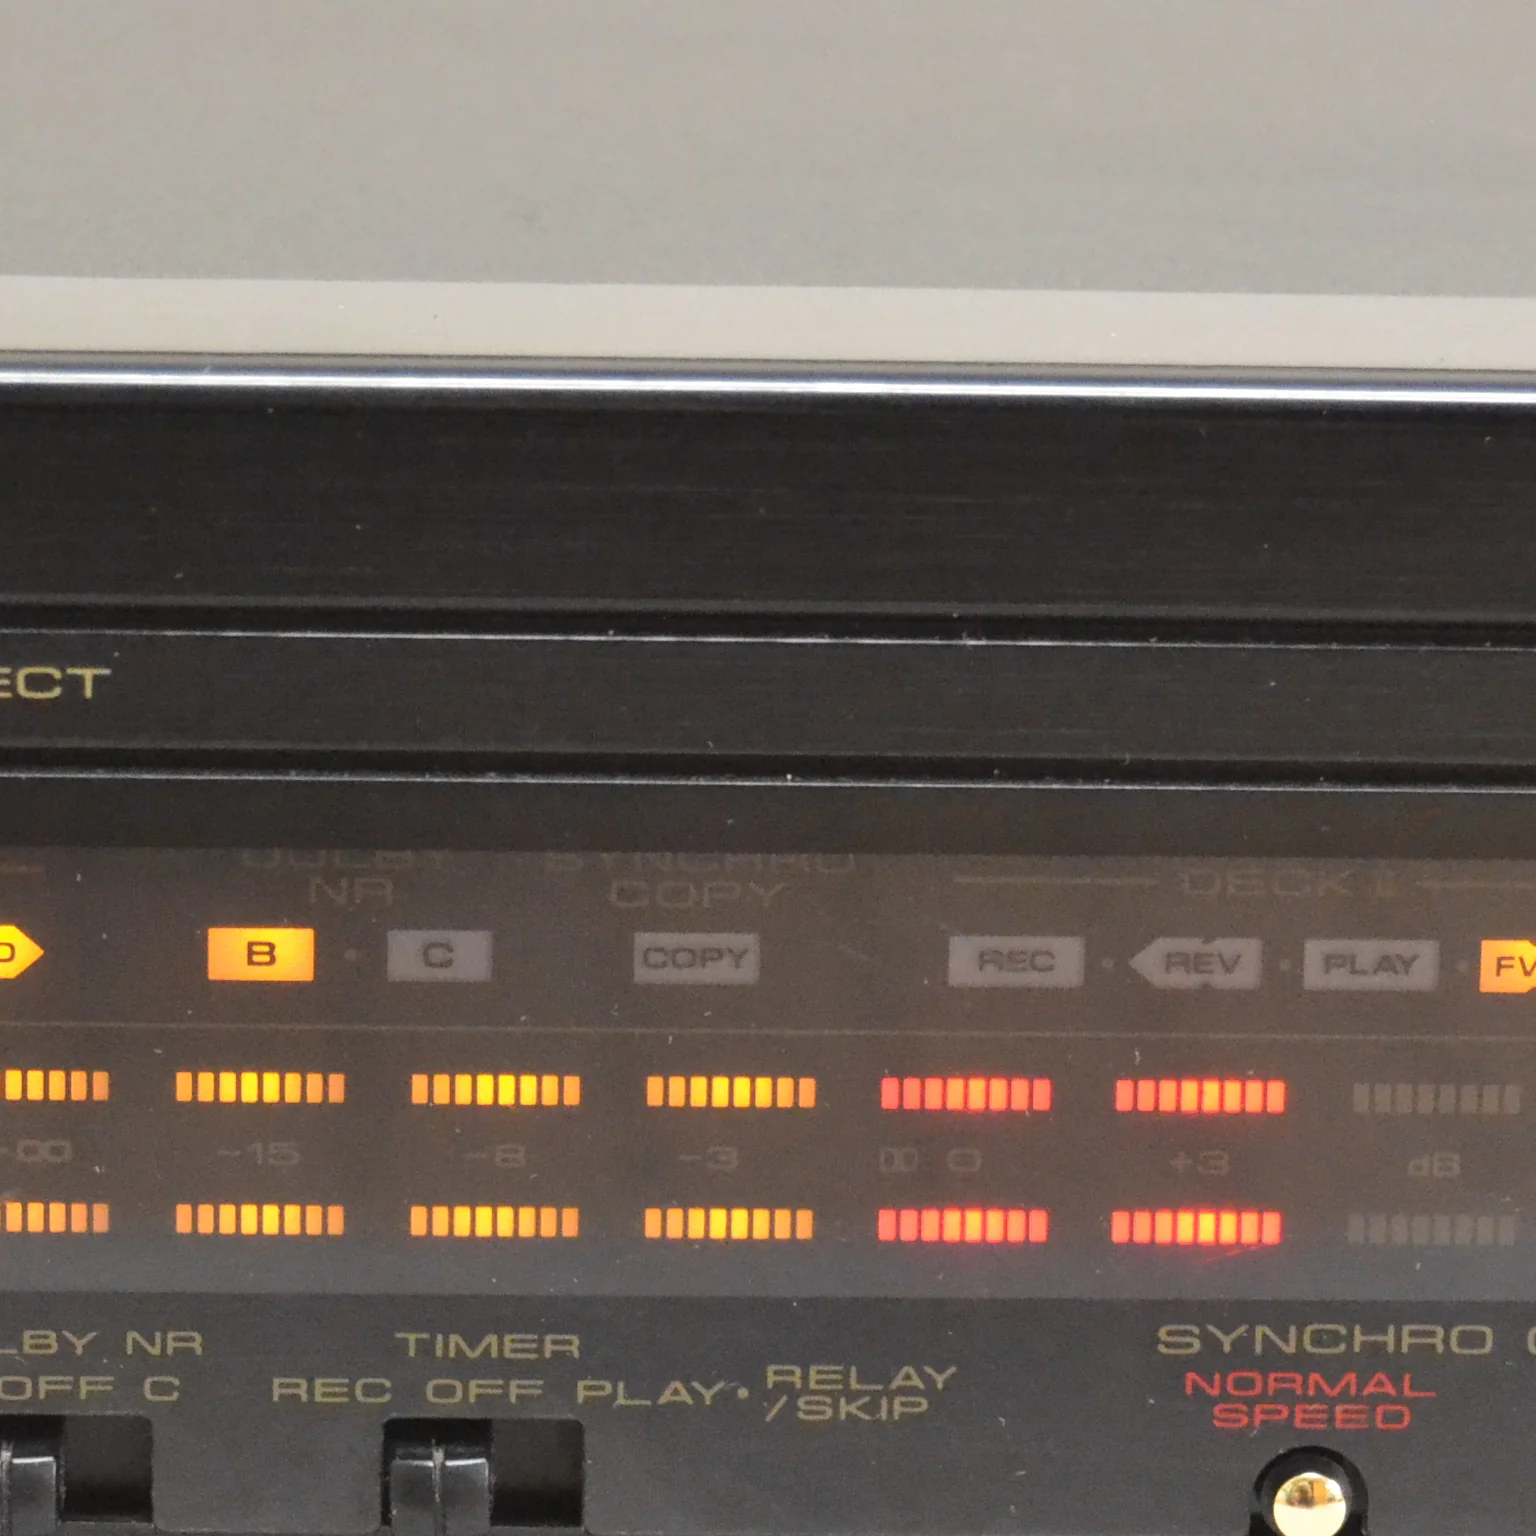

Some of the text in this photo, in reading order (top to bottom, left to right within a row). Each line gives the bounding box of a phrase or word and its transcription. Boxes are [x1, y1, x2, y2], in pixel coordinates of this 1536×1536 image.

[308, 877, 395, 906] NR
[608, 879, 786, 909] COPY
[1182, 867, 1353, 897] DECK
[247, 941, 276, 966] B
[422, 942, 453, 968] C
[642, 944, 750, 971] COPY
[977, 949, 1056, 974] REC
[1164, 951, 1244, 977] REV
[1322, 951, 1417, 977] PLAY
[1408, 1149, 1461, 1178] dB
[127, 1331, 202, 1355] NR
[396, 1333, 579, 1359] TIMER
[1158, 1324, 1493, 1355] SYNCHRO
[143, 1376, 180, 1401] C
[767, 1364, 956, 1390] RELAY
[1184, 1371, 1436, 1397] NORMAL
[273, 1378, 391, 1403] REC
[426, 1379, 543, 1403] OFF
[766, 1396, 928, 1421] /SKIP
[1212, 1402, 1412, 1432] SPEED
